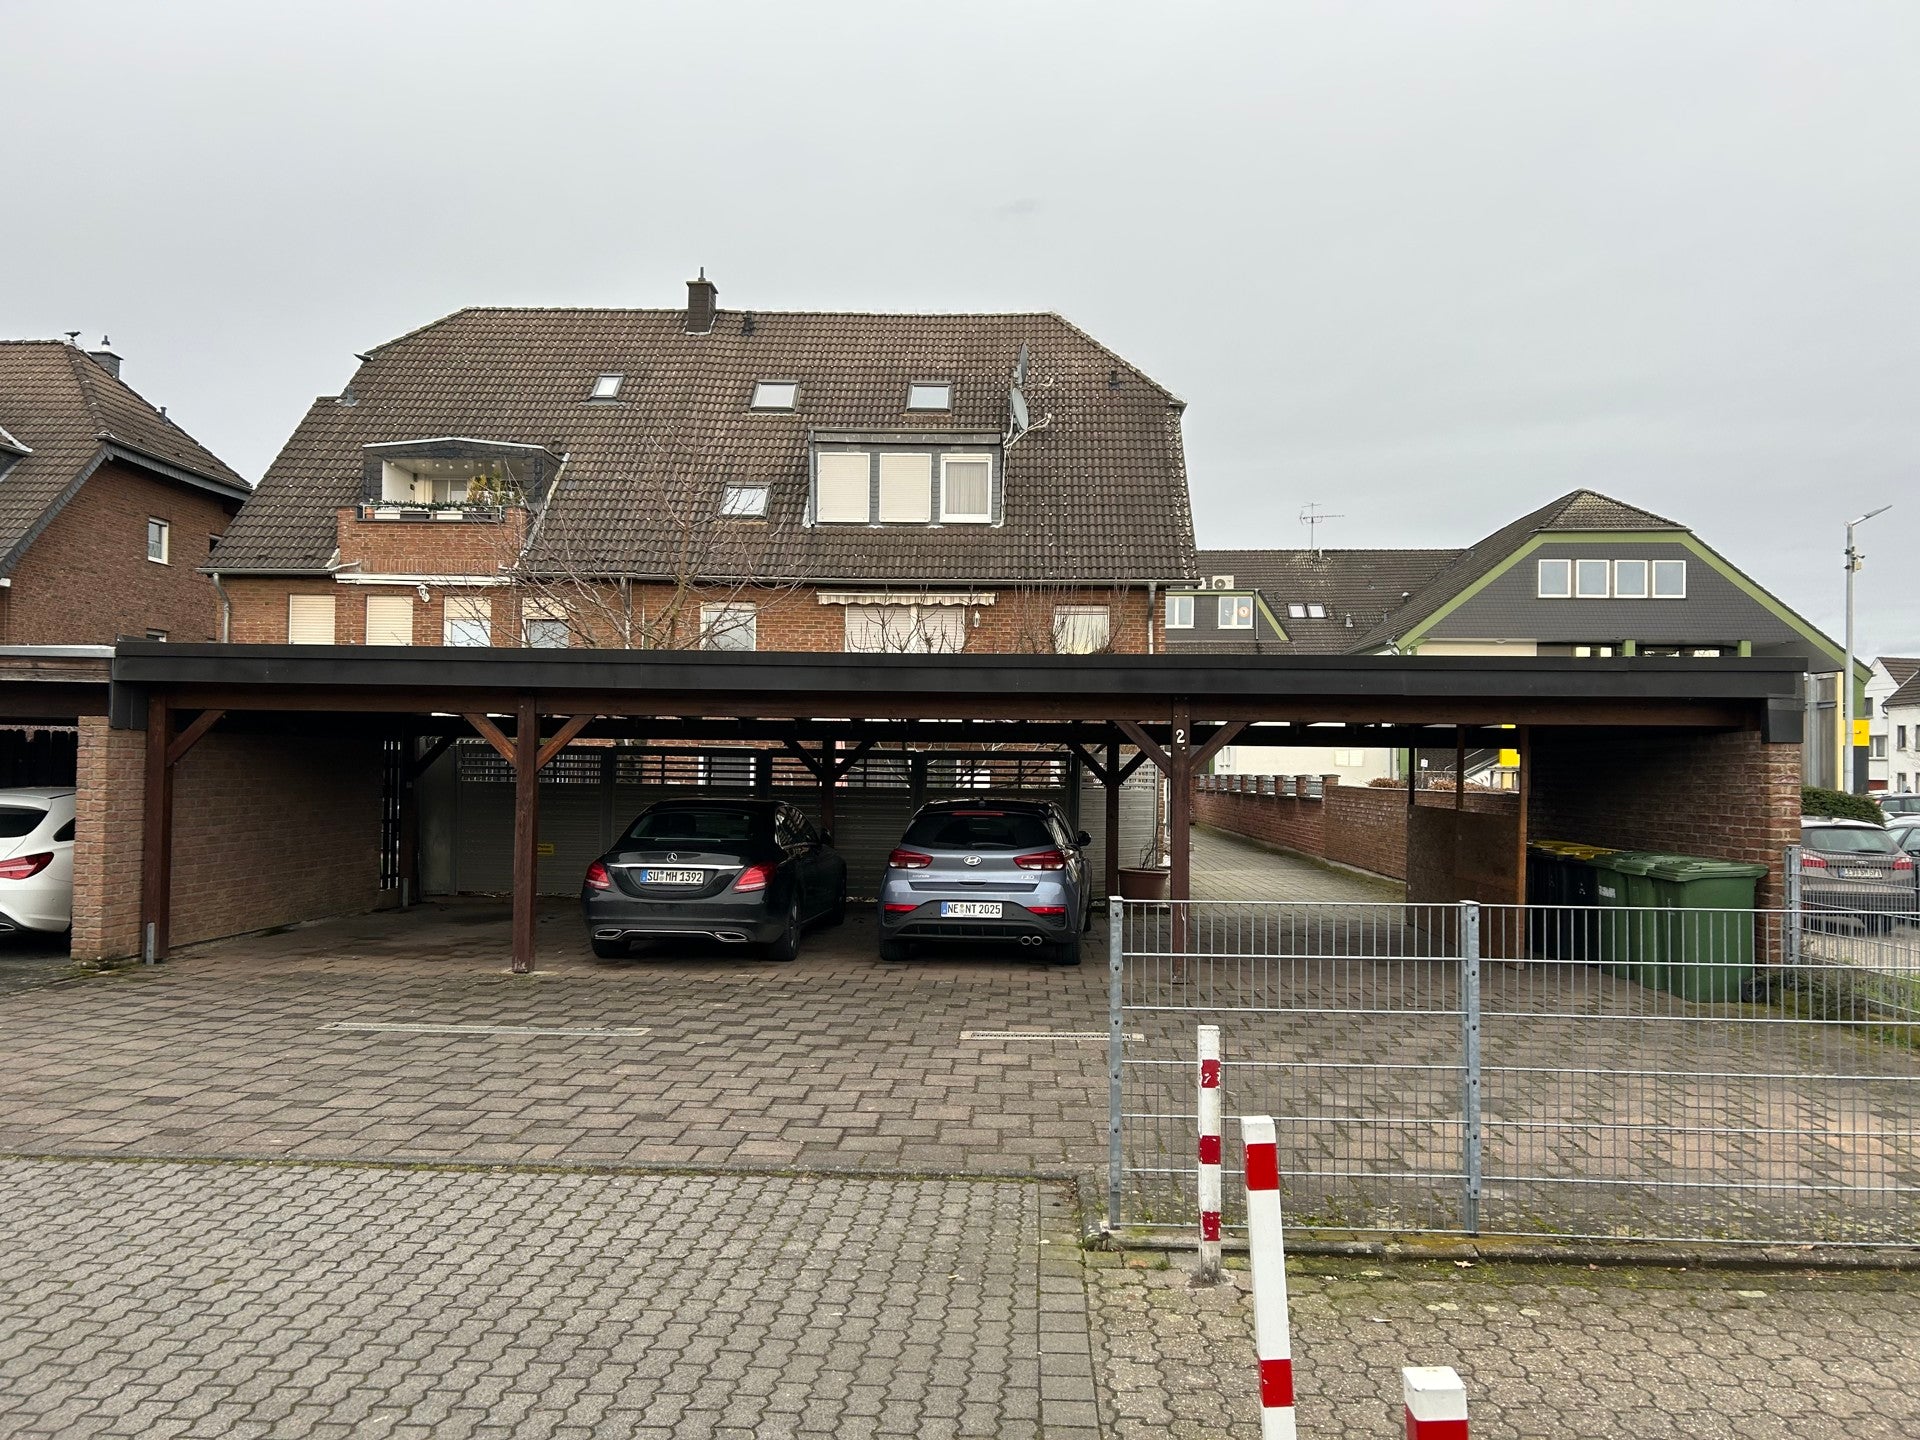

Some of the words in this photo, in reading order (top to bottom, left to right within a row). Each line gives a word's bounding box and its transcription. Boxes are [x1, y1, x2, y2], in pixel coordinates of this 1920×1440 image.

[1175, 729, 1186, 744] 2
[647, 871, 660, 882] SU
[665, 871, 678, 882] MH
[679, 871, 703, 883] 1392
[947, 903, 959, 914] NE
[965, 903, 977, 914] NT
[978, 904, 1001, 915] 2025
